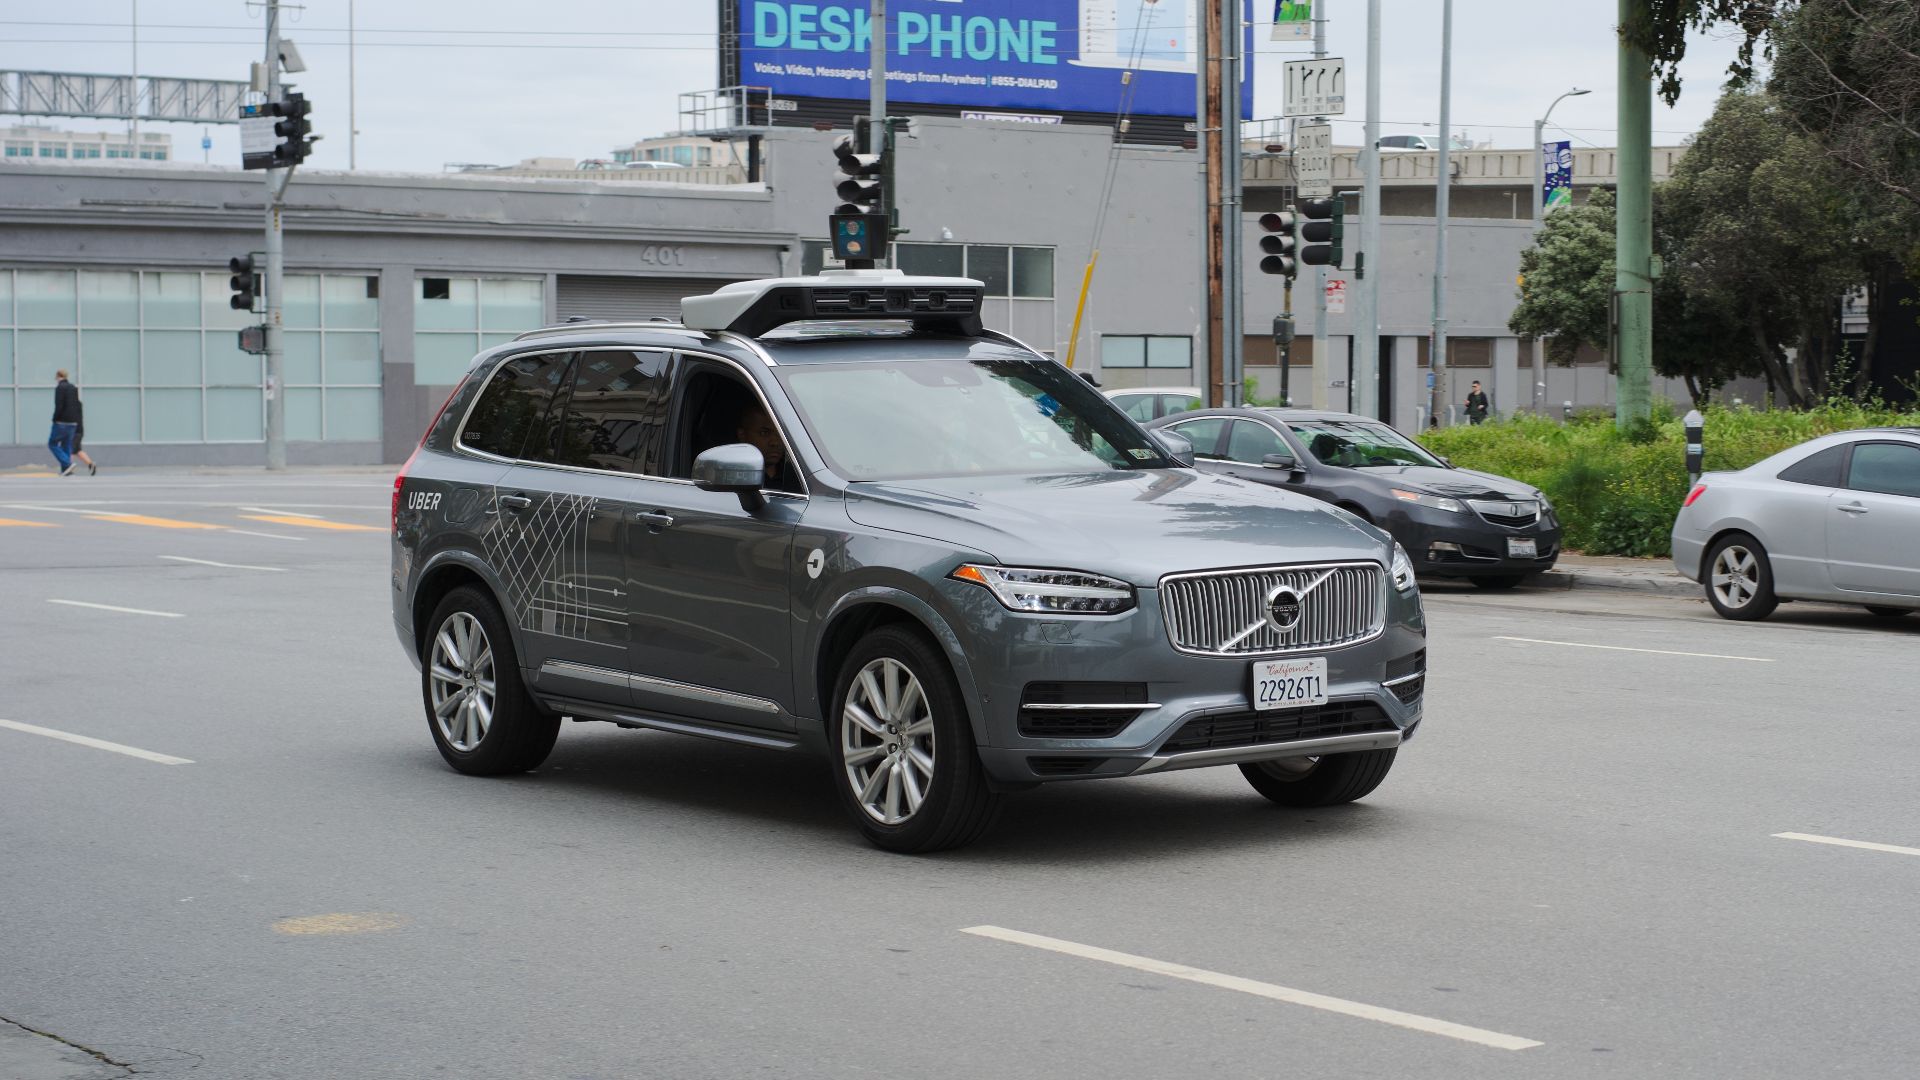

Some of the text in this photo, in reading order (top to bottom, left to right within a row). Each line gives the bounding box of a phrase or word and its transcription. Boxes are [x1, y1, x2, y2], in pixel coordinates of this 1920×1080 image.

[754, 1, 872, 52] DESK
[898, 11, 1058, 64] PHONE
[754, 62, 785, 75] Voice,
[785, 64, 815, 77] Video,
[816, 66, 866, 80] Messaging
[884, 70, 917, 83] eetings
[918, 72, 940, 82] from
[941, 74, 986, 86] Anywhere
[991, 76, 1058, 89] #855-DIALPAD
[641, 245, 686, 265] 401
[408, 491, 442, 510] UBER
[1268, 663, 1313, 677] California
[1260, 676, 1323, 702] 22926T1
